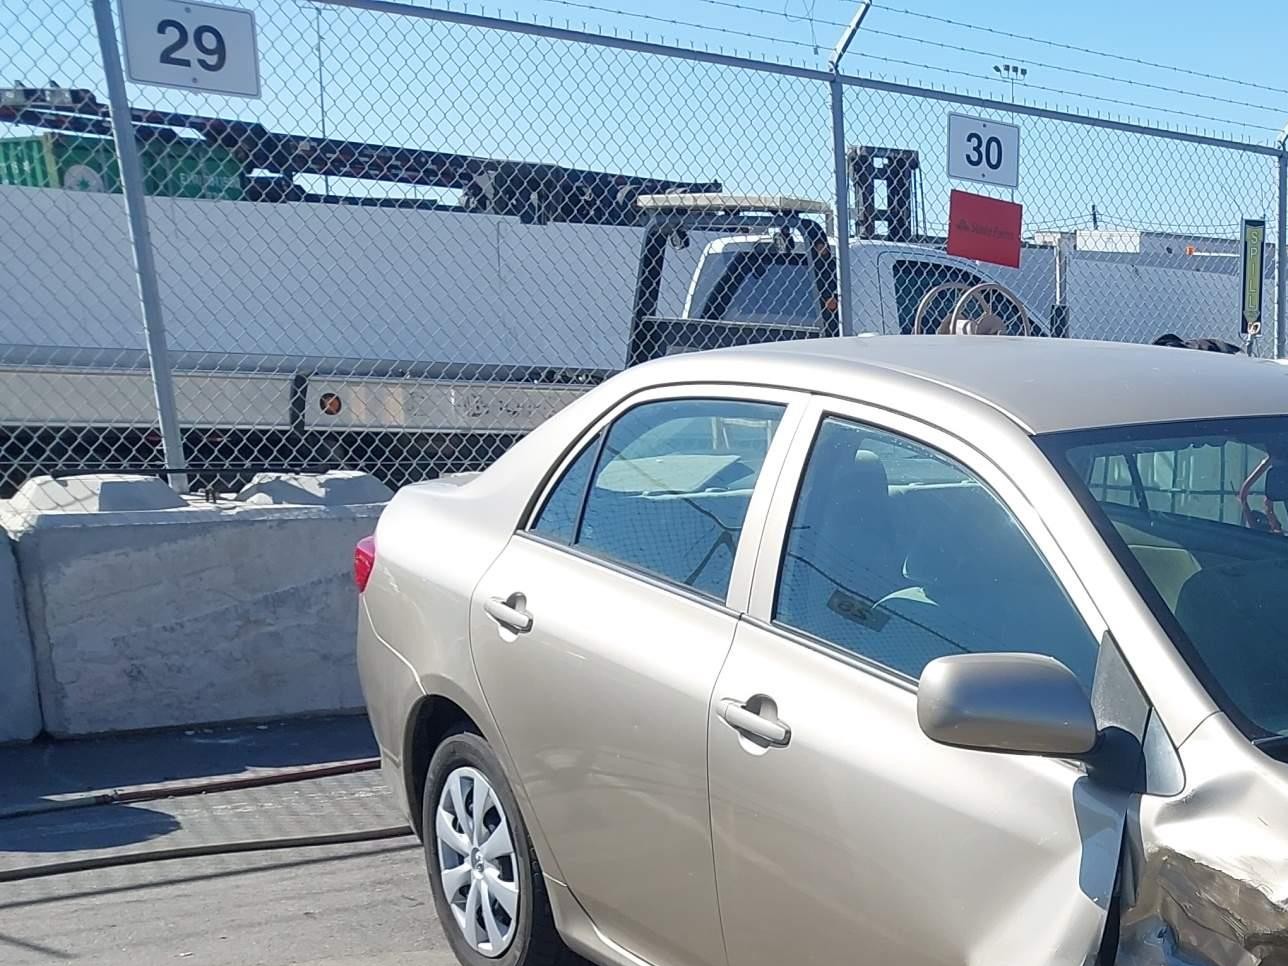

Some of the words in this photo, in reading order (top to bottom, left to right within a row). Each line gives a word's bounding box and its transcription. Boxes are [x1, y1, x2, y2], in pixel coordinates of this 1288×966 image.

[156, 18, 227, 73] 29
[965, 132, 1003, 170] 30
[1248, 230, 1259, 309] SPILL
